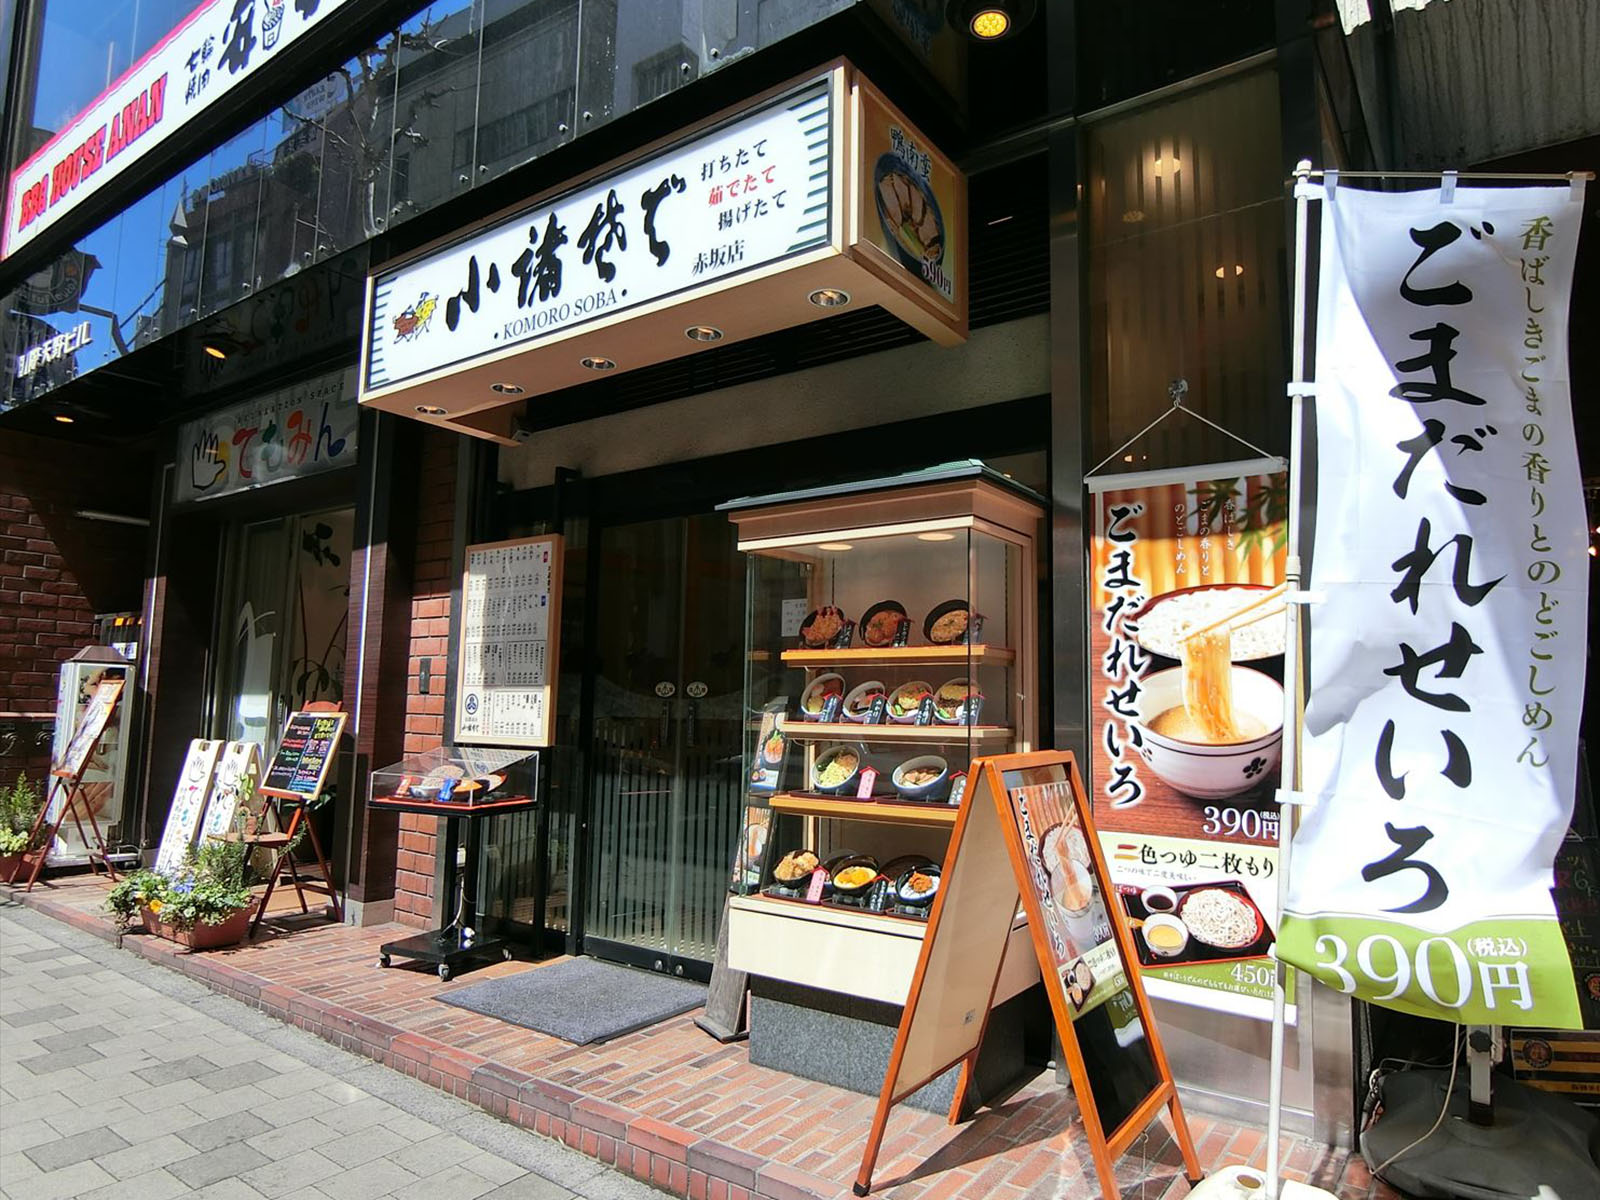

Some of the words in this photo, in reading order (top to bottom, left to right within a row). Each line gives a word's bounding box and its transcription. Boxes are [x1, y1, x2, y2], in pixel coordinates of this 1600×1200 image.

[49, 123, 107, 208] HOUSE
[105, 71, 168, 164] ANAN
[700, 139, 768, 181] 打ちたて
[708, 165, 776, 208] 茹でたて
[718, 190, 786, 231] 揚げたて
[691, 239, 745, 276] 赤坂店
[503, 304, 570, 340] KOMORO
[573, 289, 618, 319] SOBA
[1517, 216, 1561, 768] 香ばしきごまの香りとのどごしめん
[1361, 221, 1508, 913] ごまだれせいろ
[1104, 503, 1146, 806] ごまだれせいろ
[1203, 806, 1279, 840] 390円
[1114, 844, 1274, 878] 二色つゆ二枚もり
[1315, 934, 1534, 1010] 390円
[1467, 937, 1528, 957] (税込)
